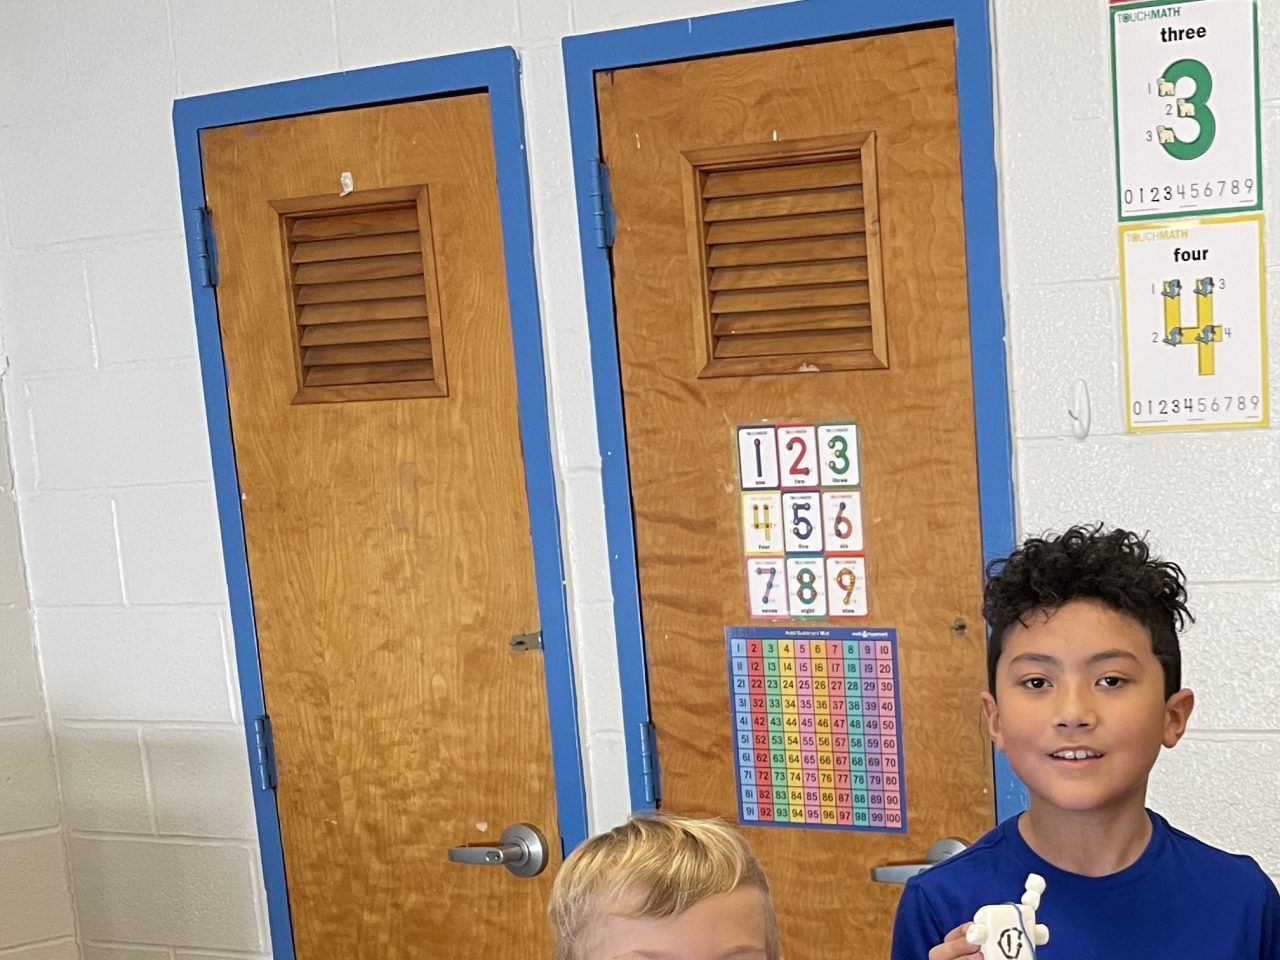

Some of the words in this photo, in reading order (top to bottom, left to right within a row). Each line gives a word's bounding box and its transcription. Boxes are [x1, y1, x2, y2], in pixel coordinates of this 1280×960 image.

[1117, 7, 1181, 23] TOUCHMATH
[1161, 26, 1207, 42] three
[1159, 58, 1216, 161] 3
[1166, 104, 1173, 115] 2
[1146, 131, 1152, 142] 3
[1173, 248, 1209, 262] four
[1219, 279, 1225, 289] 3
[1163, 279, 1223, 375] 4
[1225, 327, 1231, 338] 4
[1152, 332, 1159, 343] 2
[754, 438, 762, 477] 1
[786, 436, 810, 476] 2
[828, 435, 850, 475] 3
[753, 504, 772, 541] 4
[792, 503, 813, 540] 5
[834, 502, 852, 539] 6
[756, 567, 776, 604] 7
[796, 568, 818, 605] 8
[836, 567, 856, 605] 9
[751, 644, 757, 653] 2
[768, 644, 774, 653] 3
[784, 644, 789, 653] 4
[799, 644, 806, 653] 5
[815, 645, 821, 654] 6
[832, 645, 838, 654] 7
[848, 645, 854, 654] 8
[864, 645, 871, 654] 9
[880, 645, 889, 655] 10
[737, 662, 743, 671] 11
[751, 662, 759, 671] 12
[768, 662, 776, 671] 13
[784, 663, 792, 671] 14
[799, 663, 808, 672] 15
[815, 663, 823, 672] 16
[831, 663, 840, 672] 17
[848, 664, 857, 673] 18
[864, 664, 873, 673] 19
[879, 664, 891, 673] 20
[737, 679, 745, 688] 21
[751, 679, 762, 688] 22
[767, 680, 778, 689] 23
[783, 680, 794, 689] 24
[799, 680, 810, 689] 25
[814, 681, 826, 690] 26
[831, 681, 842, 690] 27
[847, 681, 859, 691] 28
[864, 682, 875, 691] 29
[881, 682, 893, 692] 30
[738, 698, 747, 707] 31
[753, 698, 764, 708] 32
[769, 699, 780, 708] 33
[785, 699, 796, 708] 34
[800, 700, 812, 709] 35
[816, 700, 828, 709] 36
[832, 700, 844, 710] 37
[865, 702, 877, 711] 39
[881, 702, 893, 711] 40
[739, 717, 748, 725] 41
[754, 717, 765, 726] 42
[770, 717, 781, 726] 43
[786, 718, 797, 727] 44
[801, 718, 813, 727] 45
[817, 718, 828, 728] 46
[834, 719, 845, 728] 47
[849, 720, 861, 729] 48
[866, 720, 878, 729] 49
[882, 721, 894, 730] 50
[741, 735, 749, 744] 51
[755, 735, 766, 744] 52
[772, 736, 783, 745] 53
[787, 736, 798, 745] 54
[803, 737, 814, 746] 55
[818, 737, 830, 747] 56
[835, 737, 846, 747] 57
[868, 739, 879, 748] 59
[883, 739, 895, 748] 60
[742, 753, 751, 762] 61
[756, 753, 768, 763] 62
[773, 754, 784, 763] 63
[788, 754, 799, 763] 64
[804, 755, 815, 764] 65
[836, 756, 847, 765] 67
[868, 757, 880, 767] 69
[885, 758, 896, 768] 70
[744, 770, 752, 779] 71
[758, 771, 769, 780] 72
[774, 771, 786, 781] 73
[790, 772, 801, 781] 74
[805, 773, 817, 782] 75
[821, 773, 832, 783] 76
[838, 774, 848, 783] 77
[853, 775, 865, 784] 78
[870, 775, 881, 785] 79
[885, 776, 897, 786] 80
[745, 789, 753, 798] 81
[759, 790, 770, 799] 82
[775, 791, 787, 800] 83
[791, 791, 802, 800] 84
[806, 792, 818, 801] 85
[838, 793, 850, 803] 87
[870, 795, 882, 804] 89
[886, 795, 898, 805] 90
[746, 806, 754, 816] 91
[760, 807, 772, 817] 92
[776, 808, 788, 817] 93
[792, 809, 803, 818] 94
[807, 810, 819, 819] 95
[823, 810, 835, 820] 96
[839, 811, 851, 820] 97
[855, 812, 867, 821] 98
[871, 813, 883, 822] 99
[886, 813, 900, 822] 100
